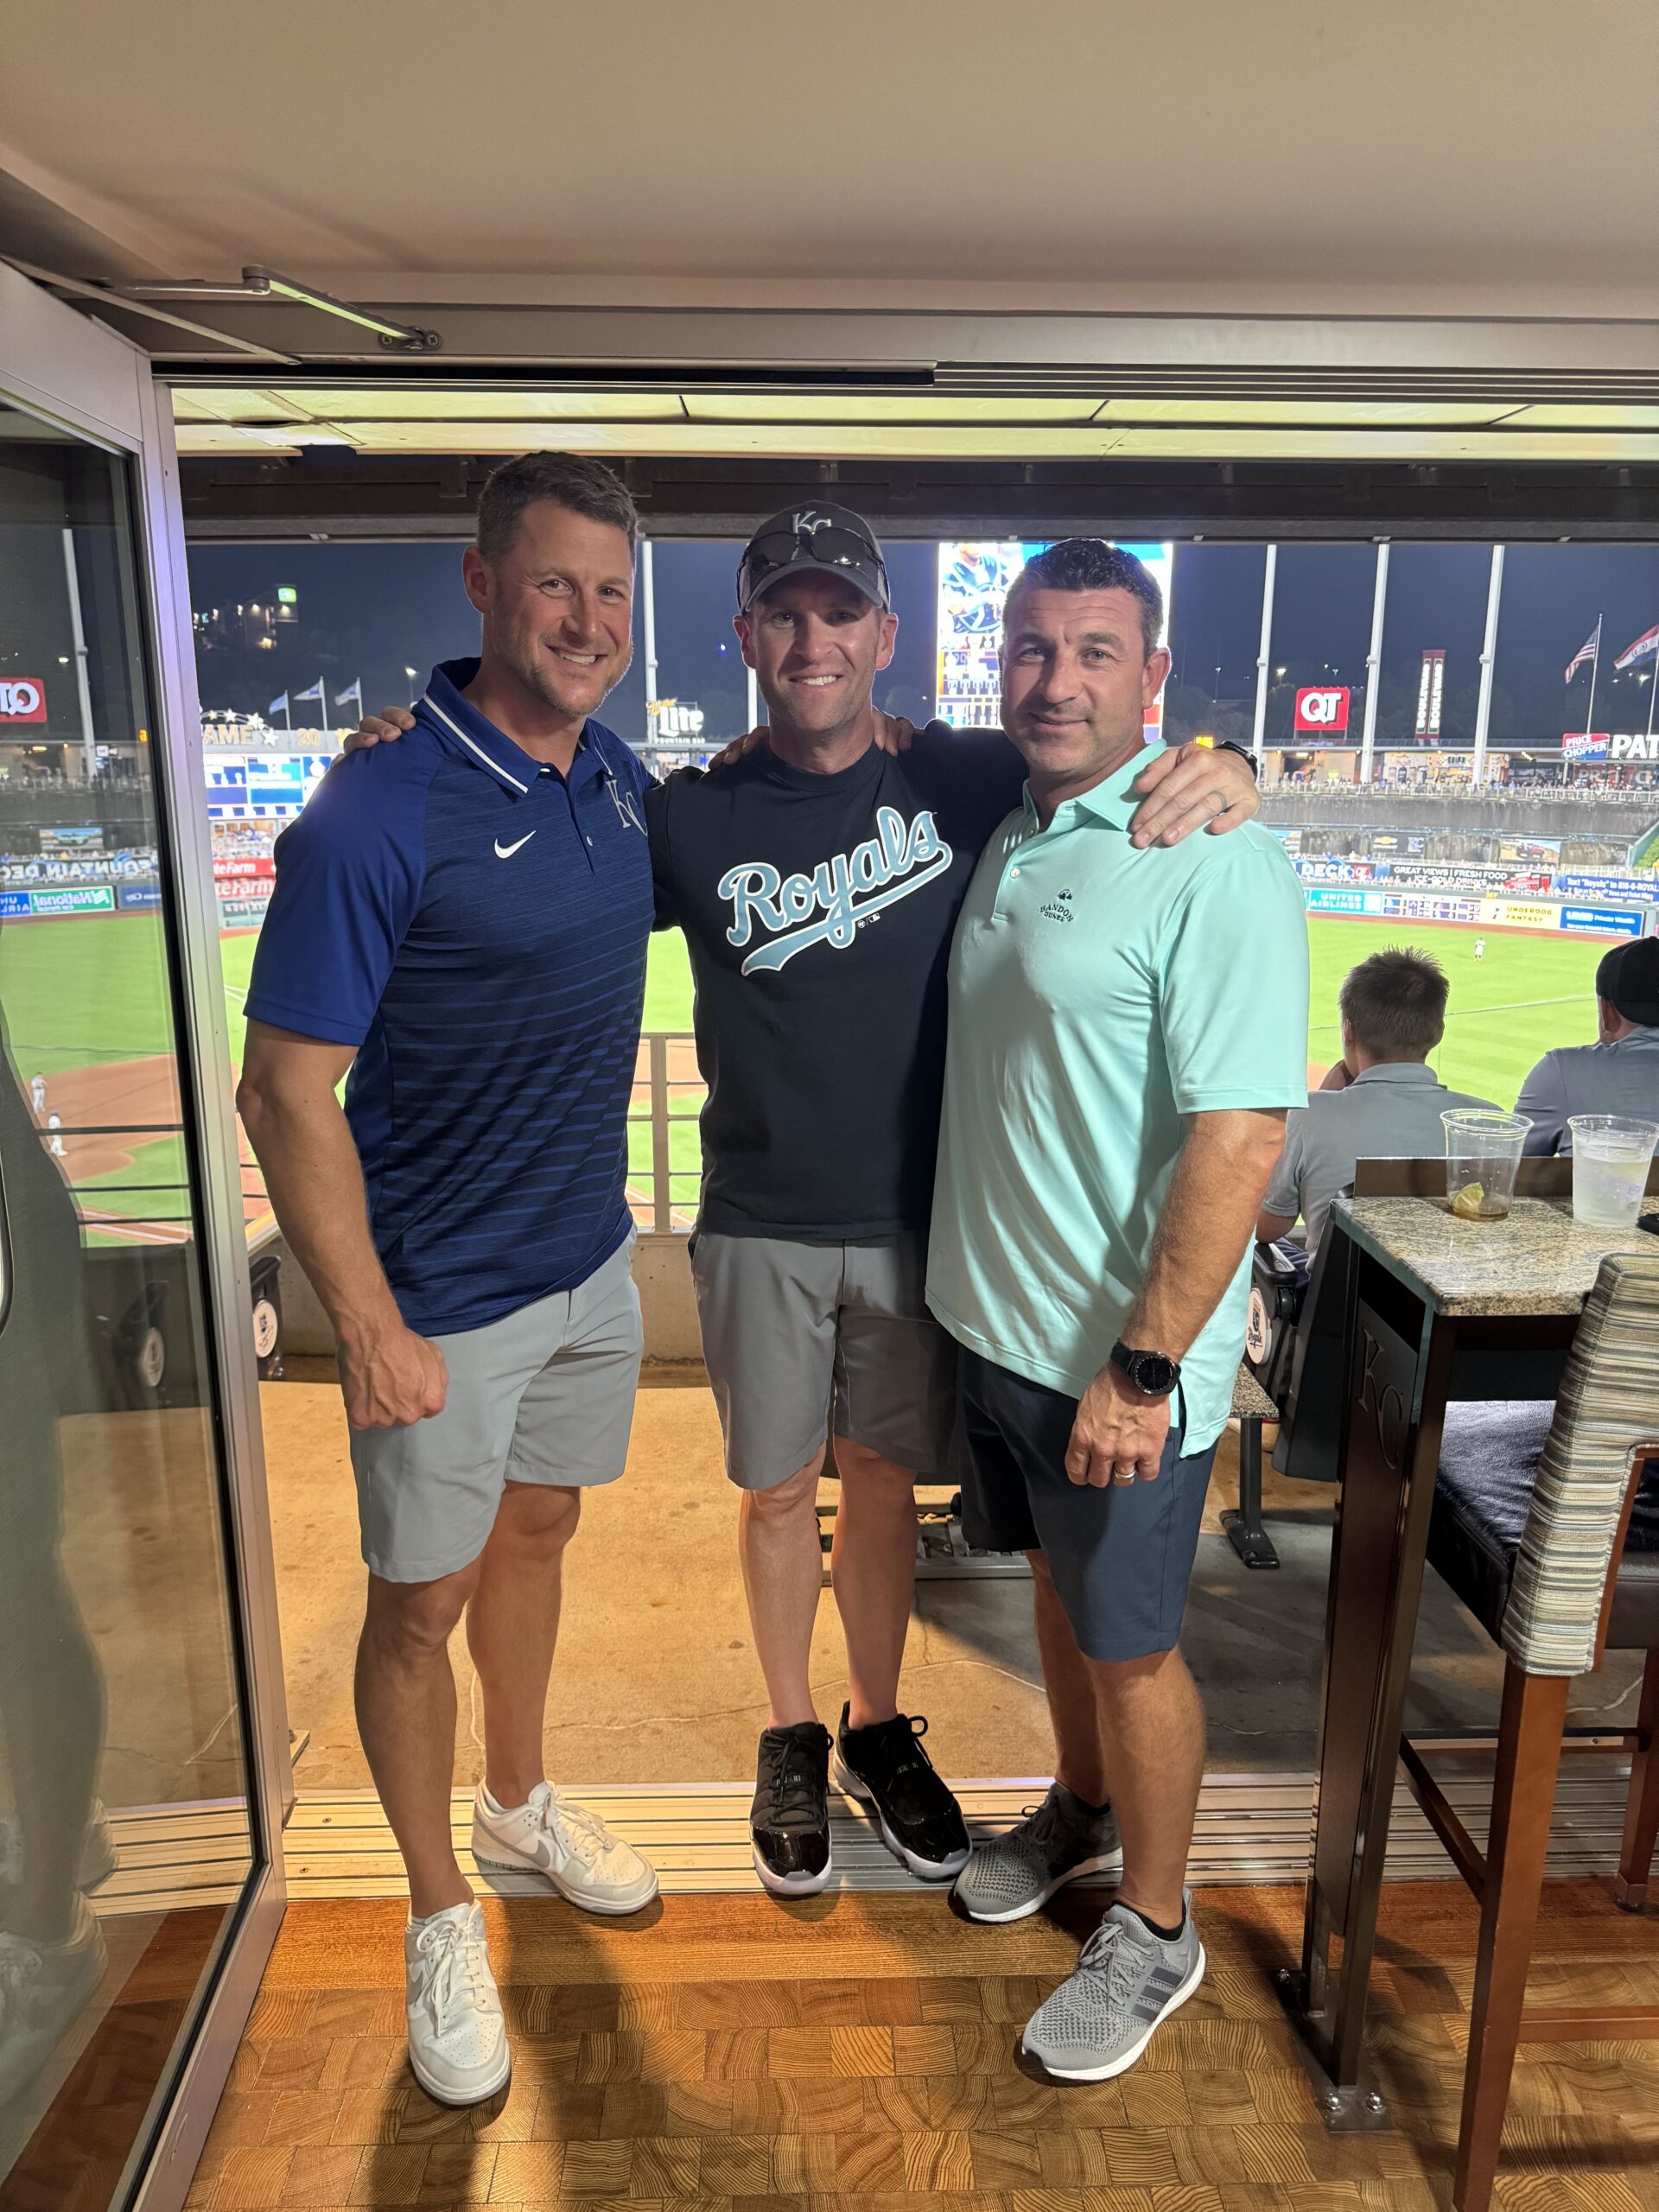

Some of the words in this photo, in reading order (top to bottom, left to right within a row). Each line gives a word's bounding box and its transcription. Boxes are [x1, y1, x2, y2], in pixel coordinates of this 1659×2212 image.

[1300, 692, 1342, 724] QT
[658, 707, 704, 737] Lite
[296, 728, 320, 747] 20
[1566, 734, 1592, 747] PRICE
[1563, 741, 1607, 758] CHOPPER
[717, 806, 940, 949] Royals
[1301, 864, 1354, 880] DECK
[1394, 866, 1421, 875] GREAT
[1422, 868, 1449, 876] VIEWS
[1454, 869, 1481, 879] FRESH
[1483, 871, 1508, 880] FOOD
[1310, 899, 1363, 910] AIRLINES
[1320, 893, 1363, 903] UNITED
[1039, 904, 1074, 923] BANDON
[1044, 911, 1065, 923] DUNES
[1506, 914, 1543, 923] FANTASY
[1507, 906, 1553, 916] UNDERDOG
[1357, 1328, 1403, 1470] KC
